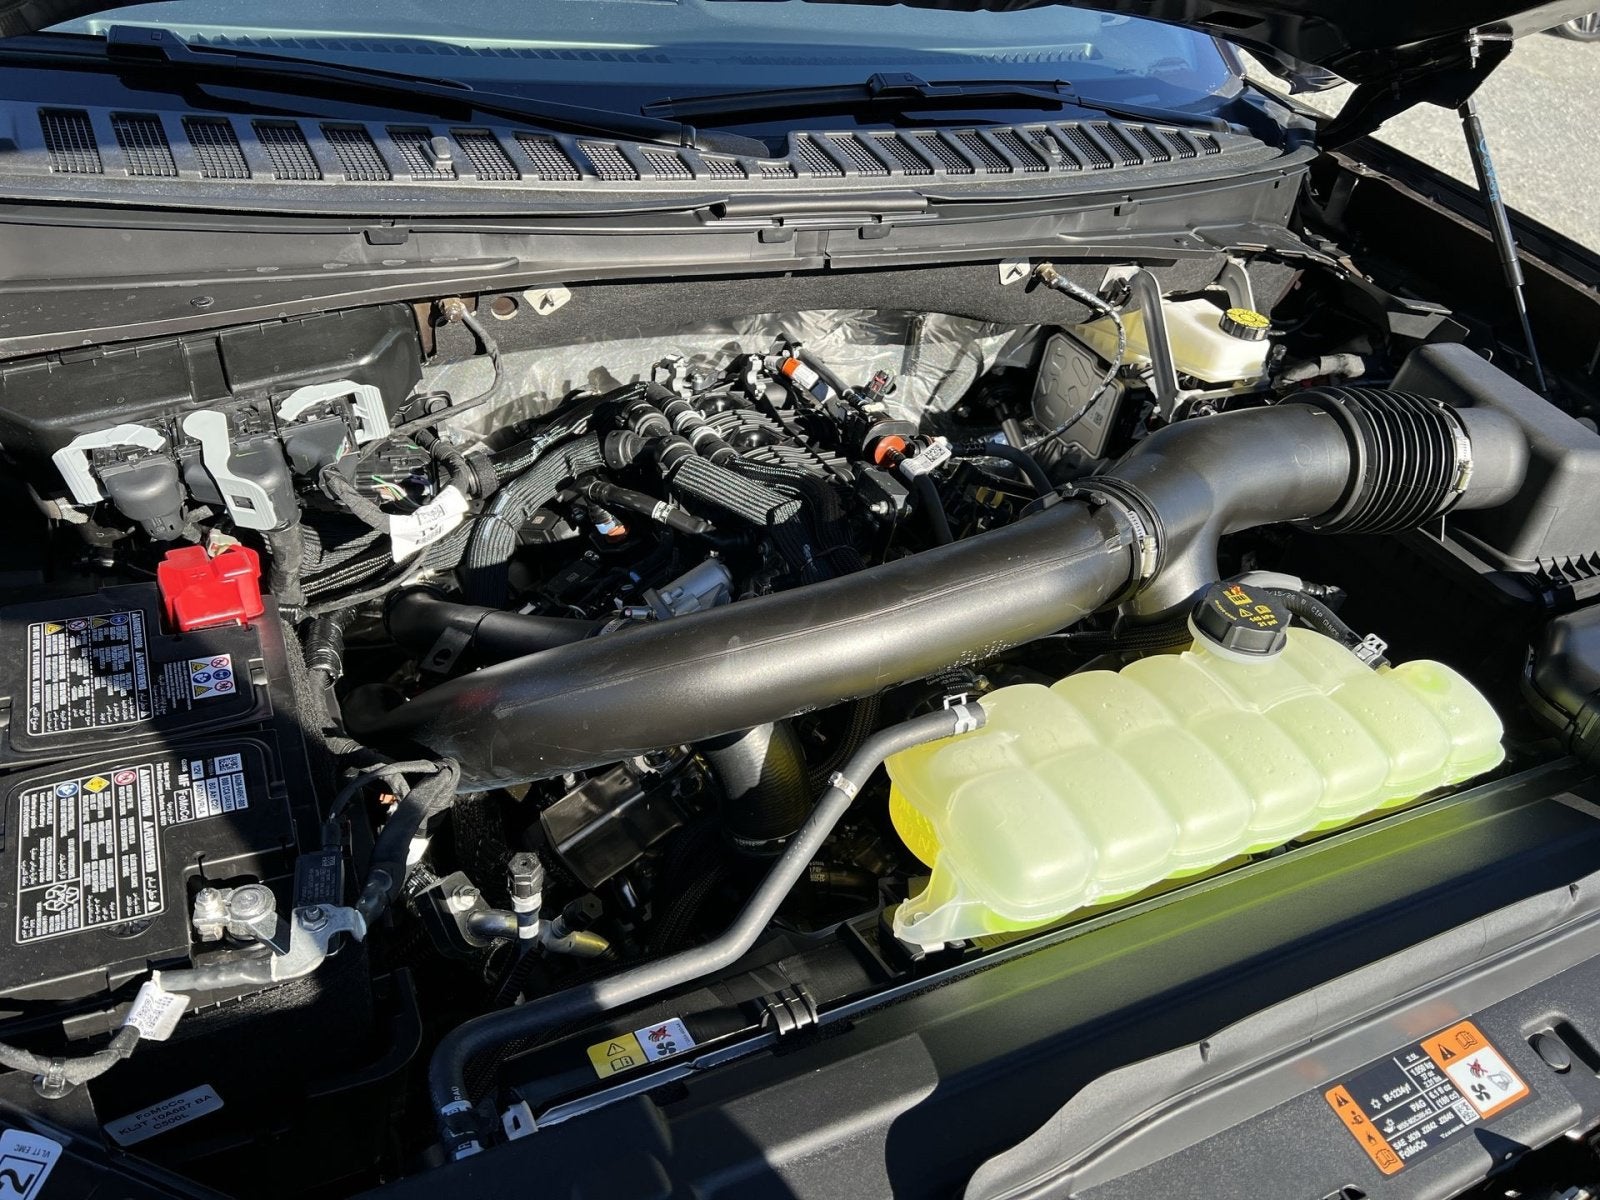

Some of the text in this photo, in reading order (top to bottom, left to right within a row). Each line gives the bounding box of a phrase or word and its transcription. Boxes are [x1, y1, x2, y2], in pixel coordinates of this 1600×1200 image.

[193, 764, 202, 775] 12V
[178, 773, 190, 787] MF
[178, 790, 190, 821] FoMoCo
[135, 1098, 185, 1121] FoMoCo
[1409, 1099, 1427, 1113] PAG
[1392, 1138, 1408, 1150] SAE
[1398, 1140, 1428, 1160] FoMoCo
